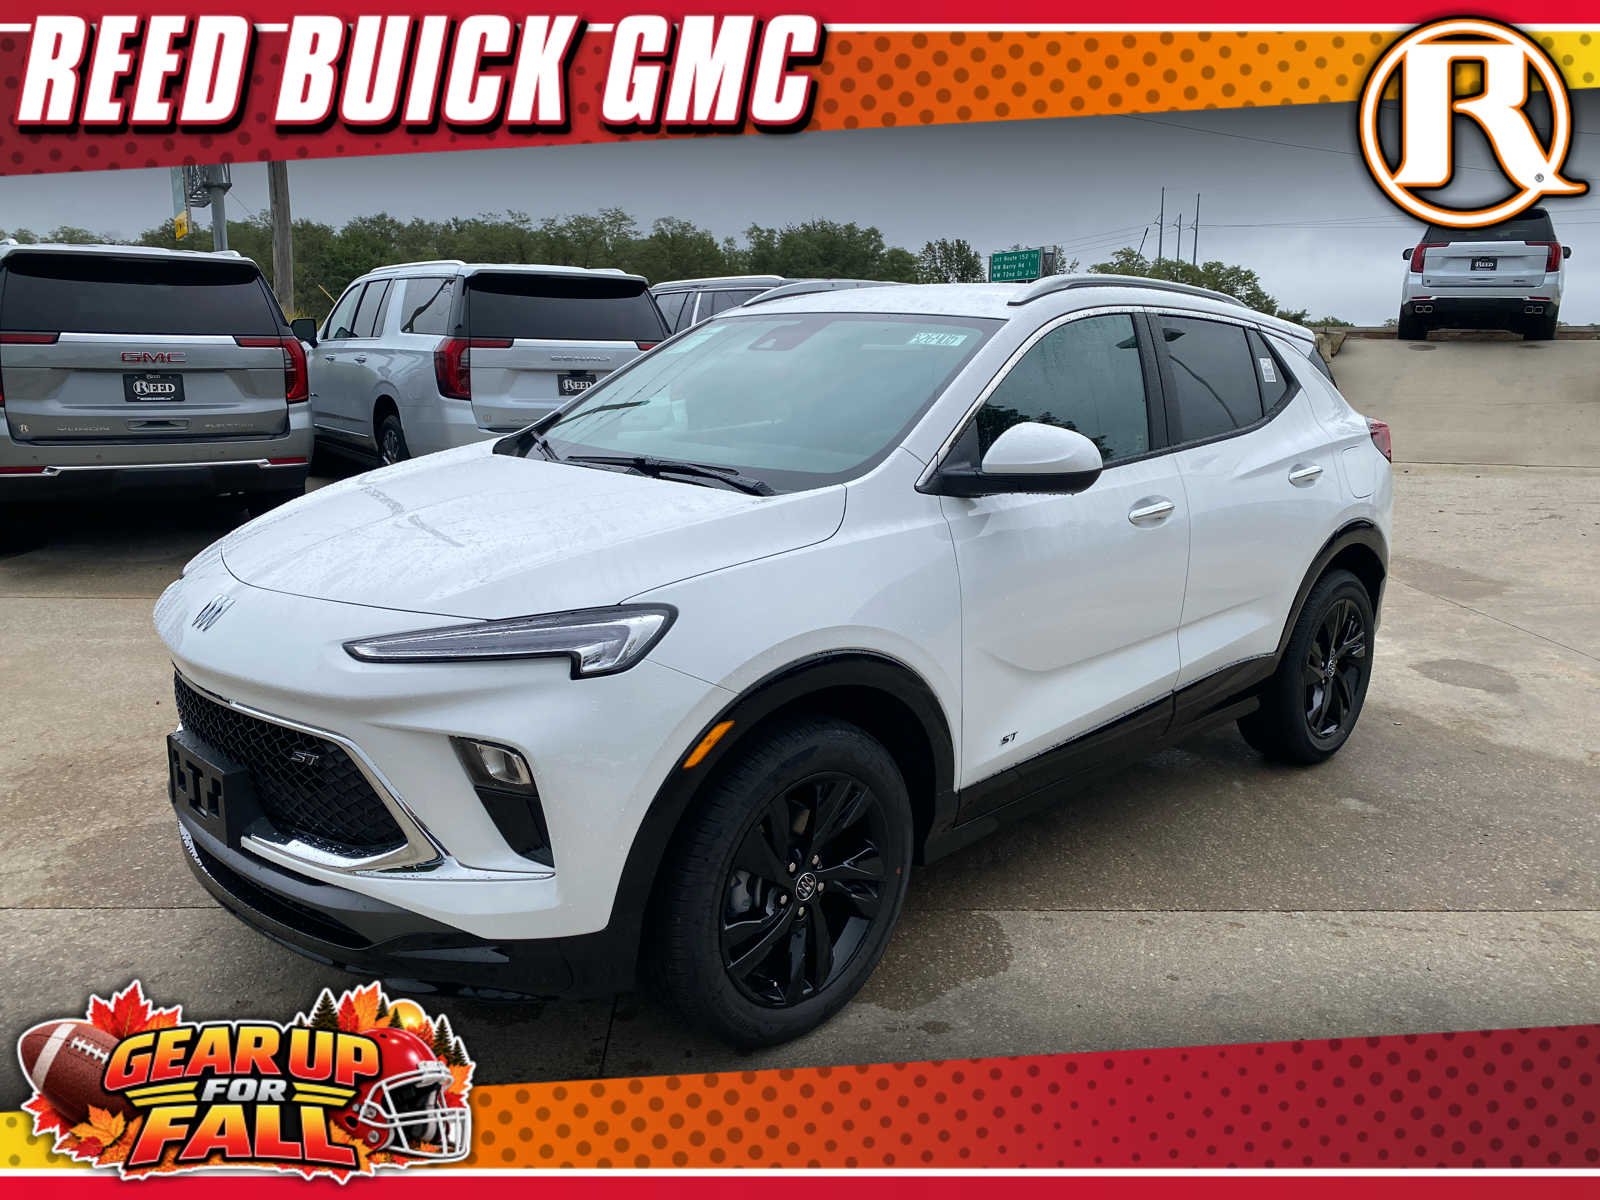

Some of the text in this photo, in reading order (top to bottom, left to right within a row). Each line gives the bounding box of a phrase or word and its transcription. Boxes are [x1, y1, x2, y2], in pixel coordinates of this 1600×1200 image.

[121, 351, 186, 363] GMC
[133, 380, 176, 395] REED
[562, 379, 593, 391] REED
[1000, 731, 1018, 745] ST
[291, 751, 319, 765] ST
